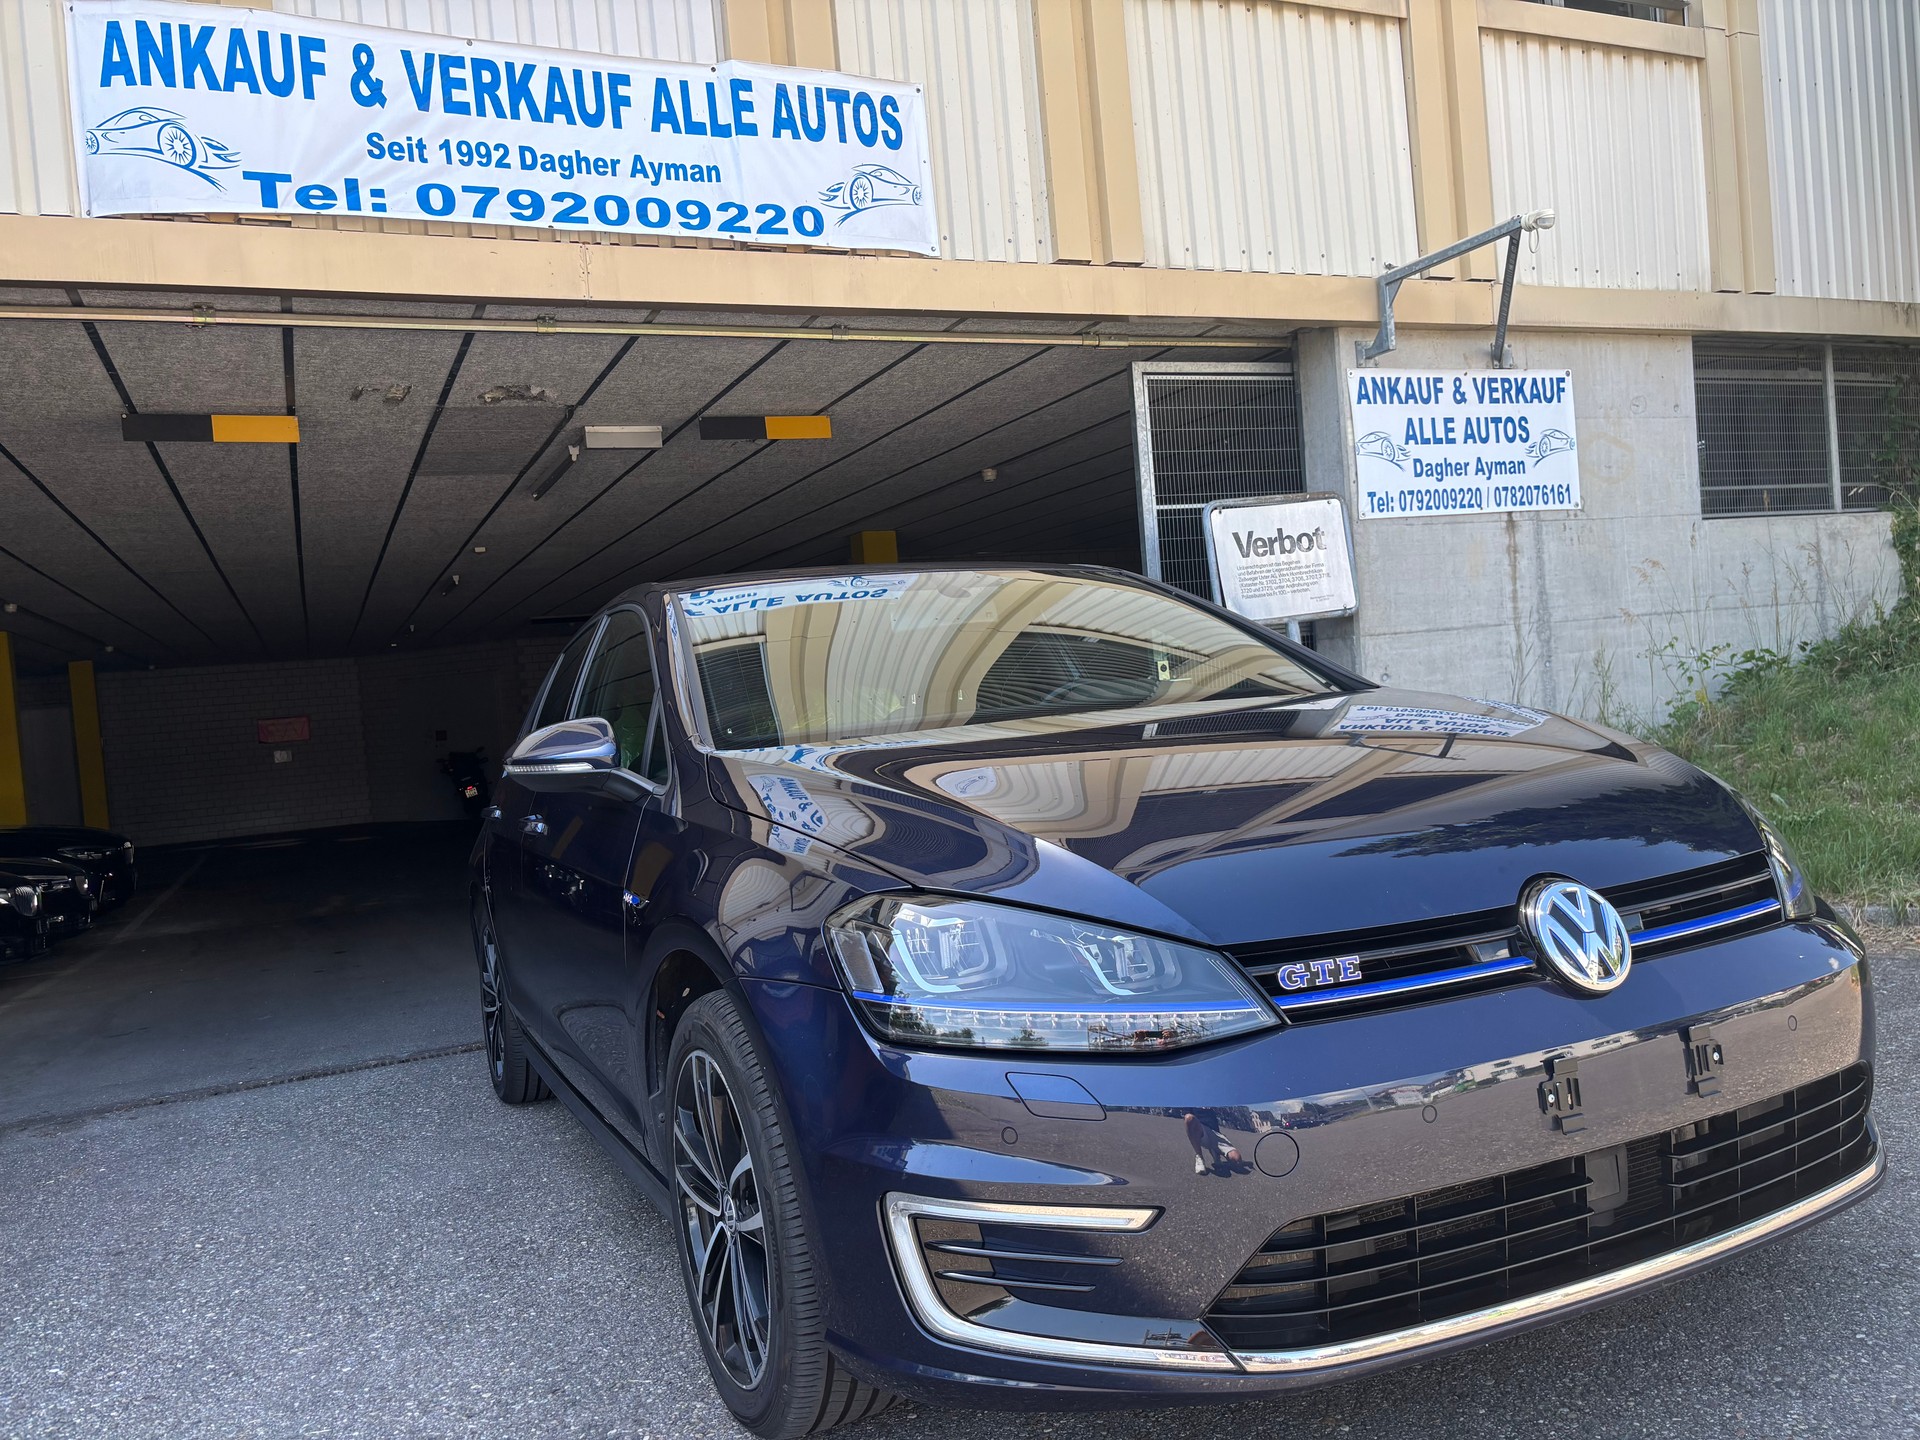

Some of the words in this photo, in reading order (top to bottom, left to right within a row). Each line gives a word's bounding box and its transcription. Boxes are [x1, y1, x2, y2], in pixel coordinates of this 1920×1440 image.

[100, 20, 326, 100] ANKAUF
[350, 43, 388, 108] &
[400, 49, 631, 130] VERKAUF
[650, 77, 758, 138] ALLE
[772, 82, 902, 150] AUTOS
[366, 132, 429, 164] Seit
[438, 140, 509, 170] 1992
[518, 145, 621, 180] Dagher
[630, 154, 722, 187] Ayman
[242, 170, 386, 212] Tel:
[415, 182, 826, 238] 0792009220
[1356, 376, 1444, 404] ANKAUF
[1452, 377, 1468, 404] &
[1472, 377, 1566, 404] VERKAUF
[1404, 417, 1457, 445] ALLE
[1463, 416, 1530, 444] AUTOS
[1412, 458, 1470, 482] Dagher
[1474, 456, 1526, 480] Ayman
[1367, 491, 1394, 513] Tel:
[1399, 488, 1482, 512] 0792009220
[1494, 484, 1572, 508] 0782076161
[1232, 526, 1327, 558] Verbot
[1277, 955, 1363, 991] GTE
